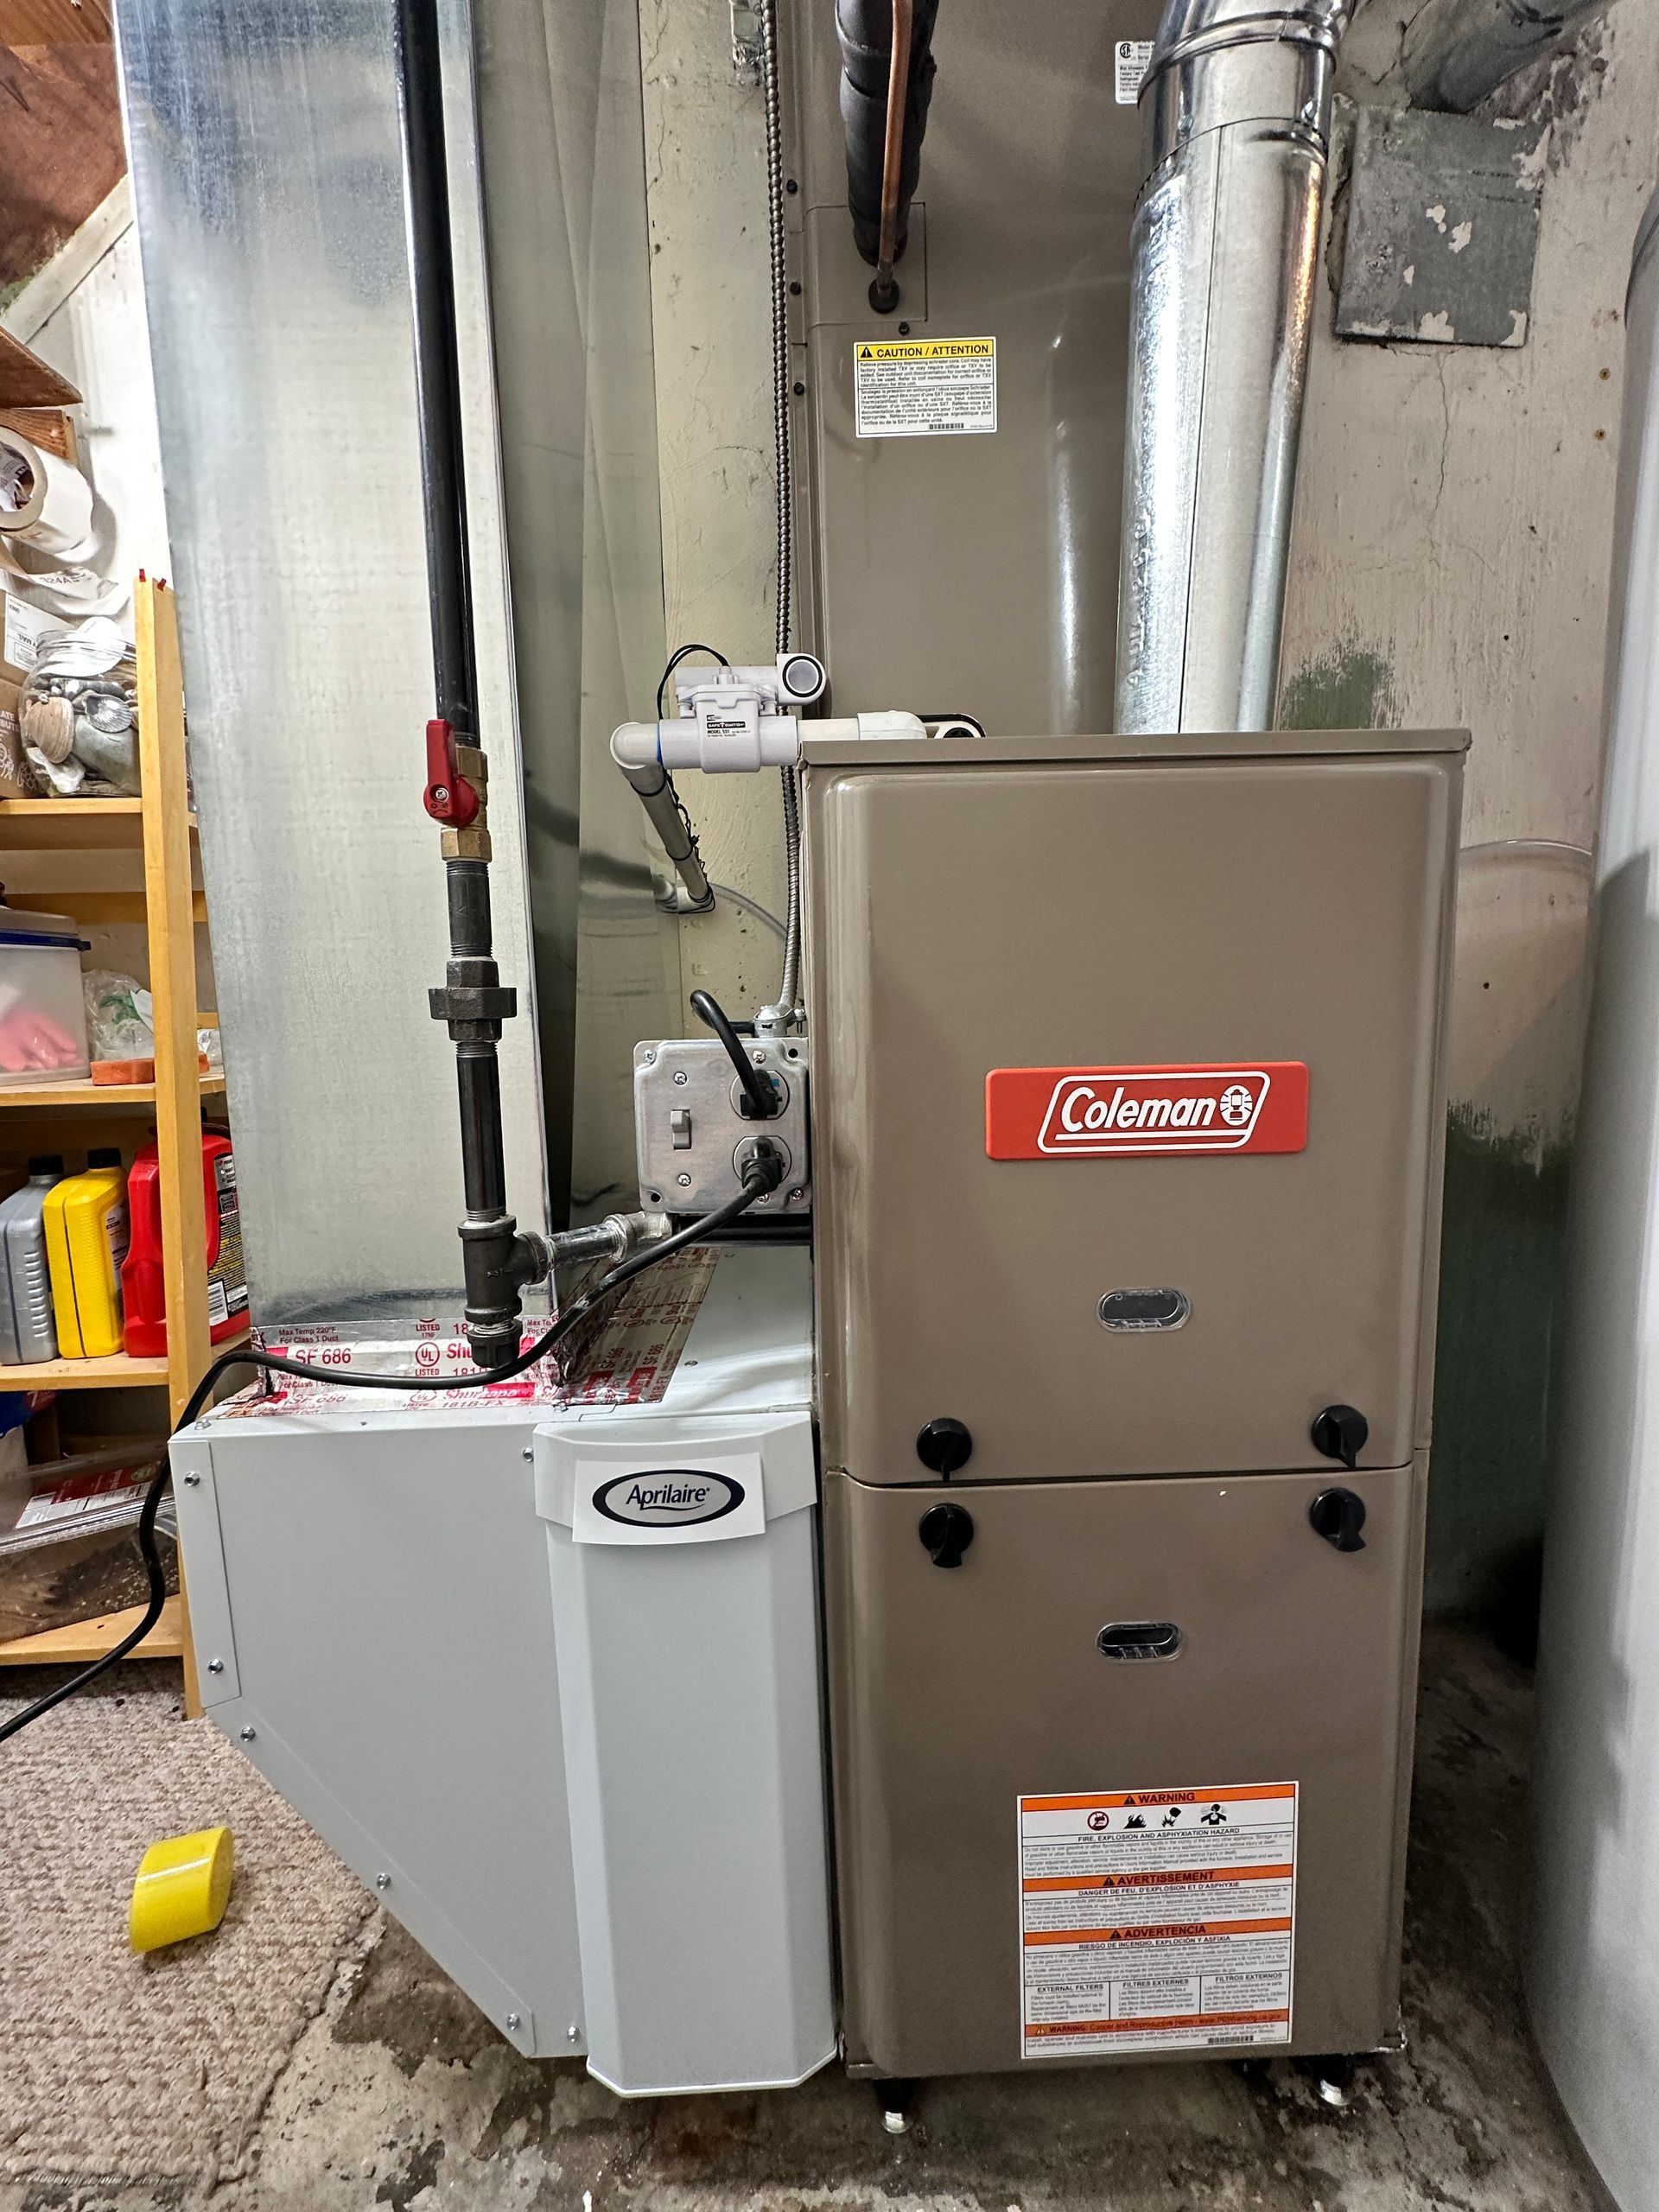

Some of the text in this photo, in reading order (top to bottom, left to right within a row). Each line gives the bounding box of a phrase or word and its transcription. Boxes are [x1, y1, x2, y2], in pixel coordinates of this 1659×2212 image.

[877, 347, 922, 358] CAUTION
[931, 345, 988, 355] ATTENTION
[1061, 1086, 1217, 1133] Coleman
[296, 1348, 352, 1364] SF 686
[1138, 1791, 1195, 1804] WARNING
[1097, 1833, 1138, 1841] EXPLOSION
[1157, 1829, 1209, 1838] ASPHYXIATION
[1116, 1871, 1215, 1885] AVERTISSEMENT
[1198, 1881, 1239, 1890] D'ASPHYXIE
[1124, 1923, 1206, 1938] ADVERTENCIA
[1048, 2023, 1086, 2033] WARNING:
